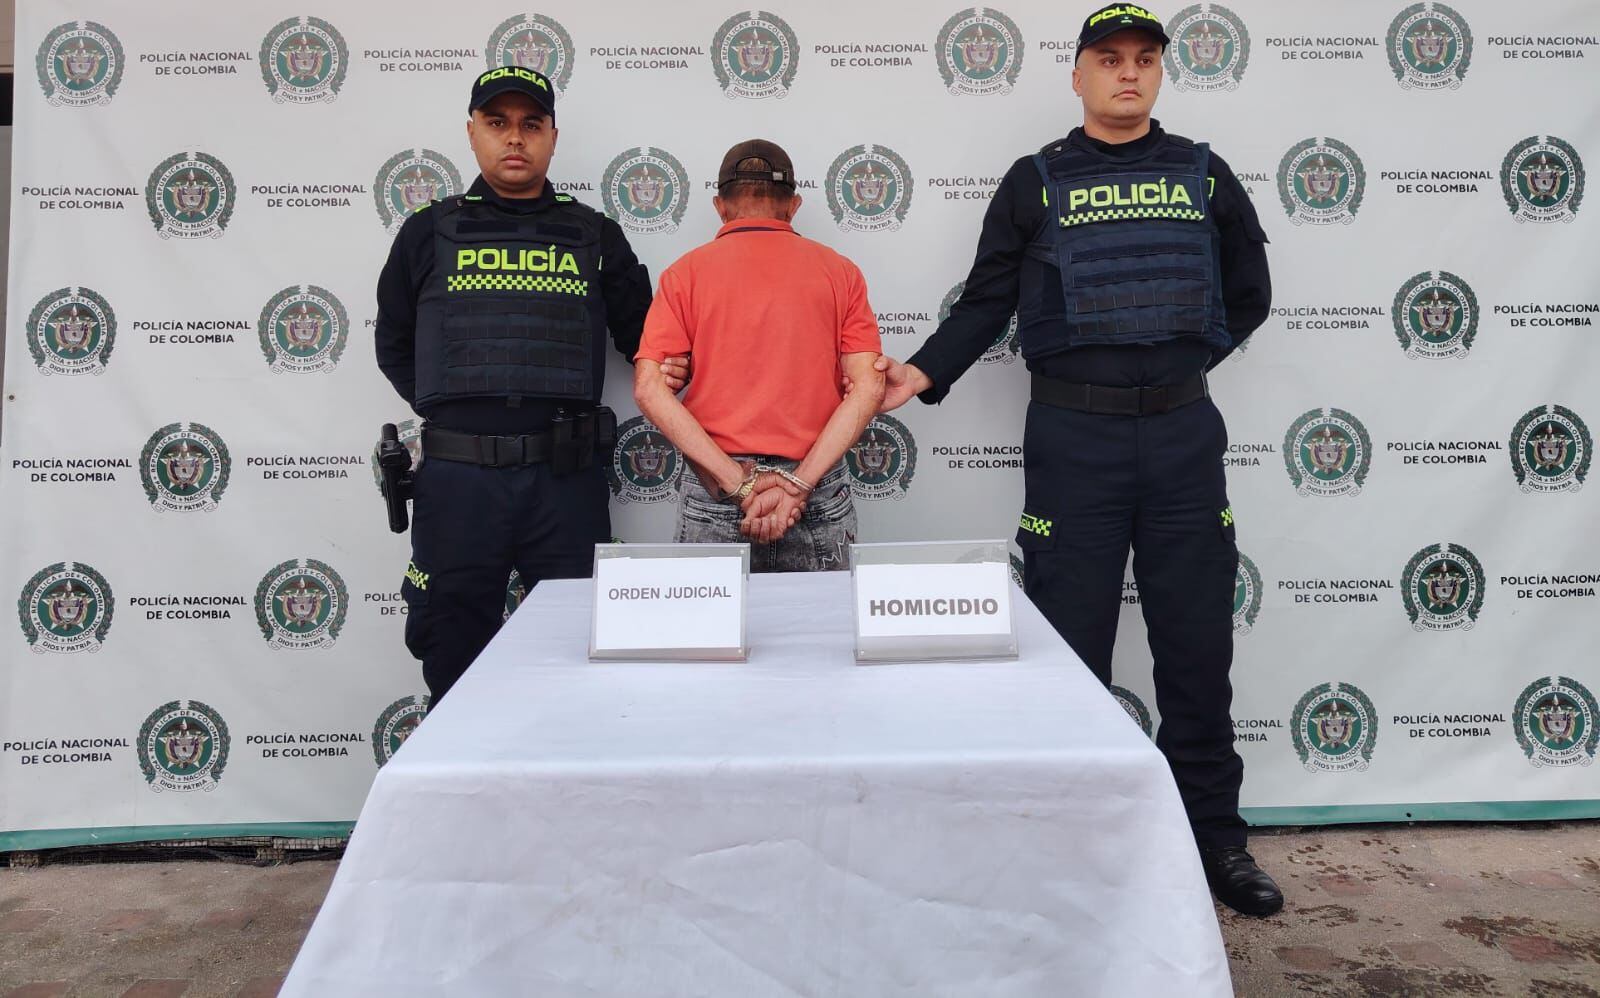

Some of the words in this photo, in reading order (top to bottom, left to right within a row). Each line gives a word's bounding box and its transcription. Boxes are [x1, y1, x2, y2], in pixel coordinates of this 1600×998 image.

[1265, 35, 1314, 47] POLICÍA
[1316, 36, 1380, 47] NACIONAL
[1487, 34, 1535, 46] POLICÍA
[1536, 36, 1600, 46] NACIONAL
[363, 47, 412, 59] POLICÍA
[414, 48, 479, 59] NACIONAL
[589, 44, 638, 57] POLICÍA
[640, 45, 705, 56] NACIONAL
[814, 42, 863, 54] POLICÍA
[864, 43, 929, 54] NACIONAL
[1503, 49, 1519, 59] DE
[1521, 49, 1585, 59] COLOMBIA
[139, 50, 187, 63] POLICÍA
[189, 51, 253, 62] NACIONAL
[1055, 54, 1072, 63] DE
[1281, 50, 1298, 60] DE
[1300, 50, 1364, 60] COLOMBIA
[379, 62, 396, 72] DE
[398, 61, 464, 72] COLOMBIA
[605, 60, 622, 70] DE
[624, 59, 689, 70] COLOMBIA
[830, 57, 847, 68] DE
[849, 56, 913, 67] COLOMBIA
[154, 66, 171, 76] DE
[173, 64, 238, 76] COLOMBIA
[1380, 168, 1429, 181] POLICÍA
[1430, 170, 1494, 180] NACIONAL
[928, 175, 977, 187] POLICÍA
[21, 184, 72, 197] POLICÍA
[74, 186, 140, 197] NACIONAL
[251, 183, 300, 195] POLICÍA
[302, 184, 368, 194] NACIONAL
[1069, 177, 1193, 211] POLICÍA
[1396, 184, 1413, 194] DE
[1415, 183, 1479, 194] COLOMBIA
[944, 190, 960, 200] DE
[39, 200, 56, 210] DE
[58, 199, 125, 210] COLOMBIA
[266, 198, 283, 208] DE
[286, 197, 351, 208] COLOMBIA
[457, 244, 580, 275] POLICÍA
[1269, 305, 1319, 318] POLICÍA
[1321, 306, 1386, 317] NACIONAL
[1493, 302, 1543, 315] POLICÍA
[1545, 303, 1600, 314] NACIONA
[875, 312, 932, 322] ACIONAL
[1510, 318, 1527, 327] DE
[1529, 316, 1592, 327] COLOMBIA
[133, 319, 184, 331] POLICÍA
[186, 320, 252, 331] NACIONAL
[878, 326, 916, 335] OMBIA
[1286, 320, 1303, 330] DE
[1305, 319, 1370, 330] COLOMBIA
[149, 334, 166, 344] DE
[169, 334, 235, 344] COLOMBIA
[932, 444, 981, 456] POLICÍA
[983, 446, 1022, 455] NACIO
[1386, 439, 1436, 452] POLICÍA
[1438, 440, 1503, 451] NACIONAL
[12, 456, 64, 469] POLICÍA
[66, 458, 133, 469] NACIONAL
[246, 454, 297, 467] POLICÍA
[299, 455, 366, 466] NACIONAL
[948, 459, 964, 469] DE
[967, 459, 1023, 469] COLOMBI
[1223, 457, 1261, 467] OMBIA
[1403, 455, 1419, 465] DE
[1422, 454, 1487, 465] COLOMBIA
[30, 472, 48, 483] DE
[50, 472, 116, 483] COLOMBIA
[263, 470, 280, 480] DE
[282, 469, 349, 480] COLOMBIA
[1277, 578, 1328, 590] POLICÍA
[1329, 579, 1394, 590] NACIONAL
[1500, 572, 1549, 586] POLICÍA
[1551, 573, 1600, 585] NACIONA
[364, 592, 401, 602] POLIC
[608, 587, 661, 601] ORDEN
[664, 585, 732, 600] JUDICIAL
[1294, 593, 1311, 604] DE
[1313, 593, 1379, 603] COLOMBIA
[1517, 589, 1533, 599] DE
[1535, 587, 1596, 599] COLOMBIA
[129, 594, 181, 607] POLICÍA
[183, 595, 248, 606] NACIONAL
[380, 606, 397, 615] DE
[869, 598, 999, 617] HOMICIDIO
[146, 610, 163, 620] DE
[166, 609, 232, 620] COLOMBIA
[1393, 712, 1441, 725] POLICÍA
[1443, 713, 1507, 724] NACIONAL
[246, 731, 296, 745] POLICÍA
[299, 732, 366, 744] NACIONAL
[1409, 728, 1425, 739] DE
[1427, 727, 1492, 738] COLOMBIA
[3, 736, 58, 752] POLICÍA
[61, 737, 130, 749] NACIONAL
[262, 748, 279, 758] DE
[281, 746, 349, 758] COLOMBIA
[21, 754, 39, 765] DE
[42, 752, 113, 764] COLOMBIA
